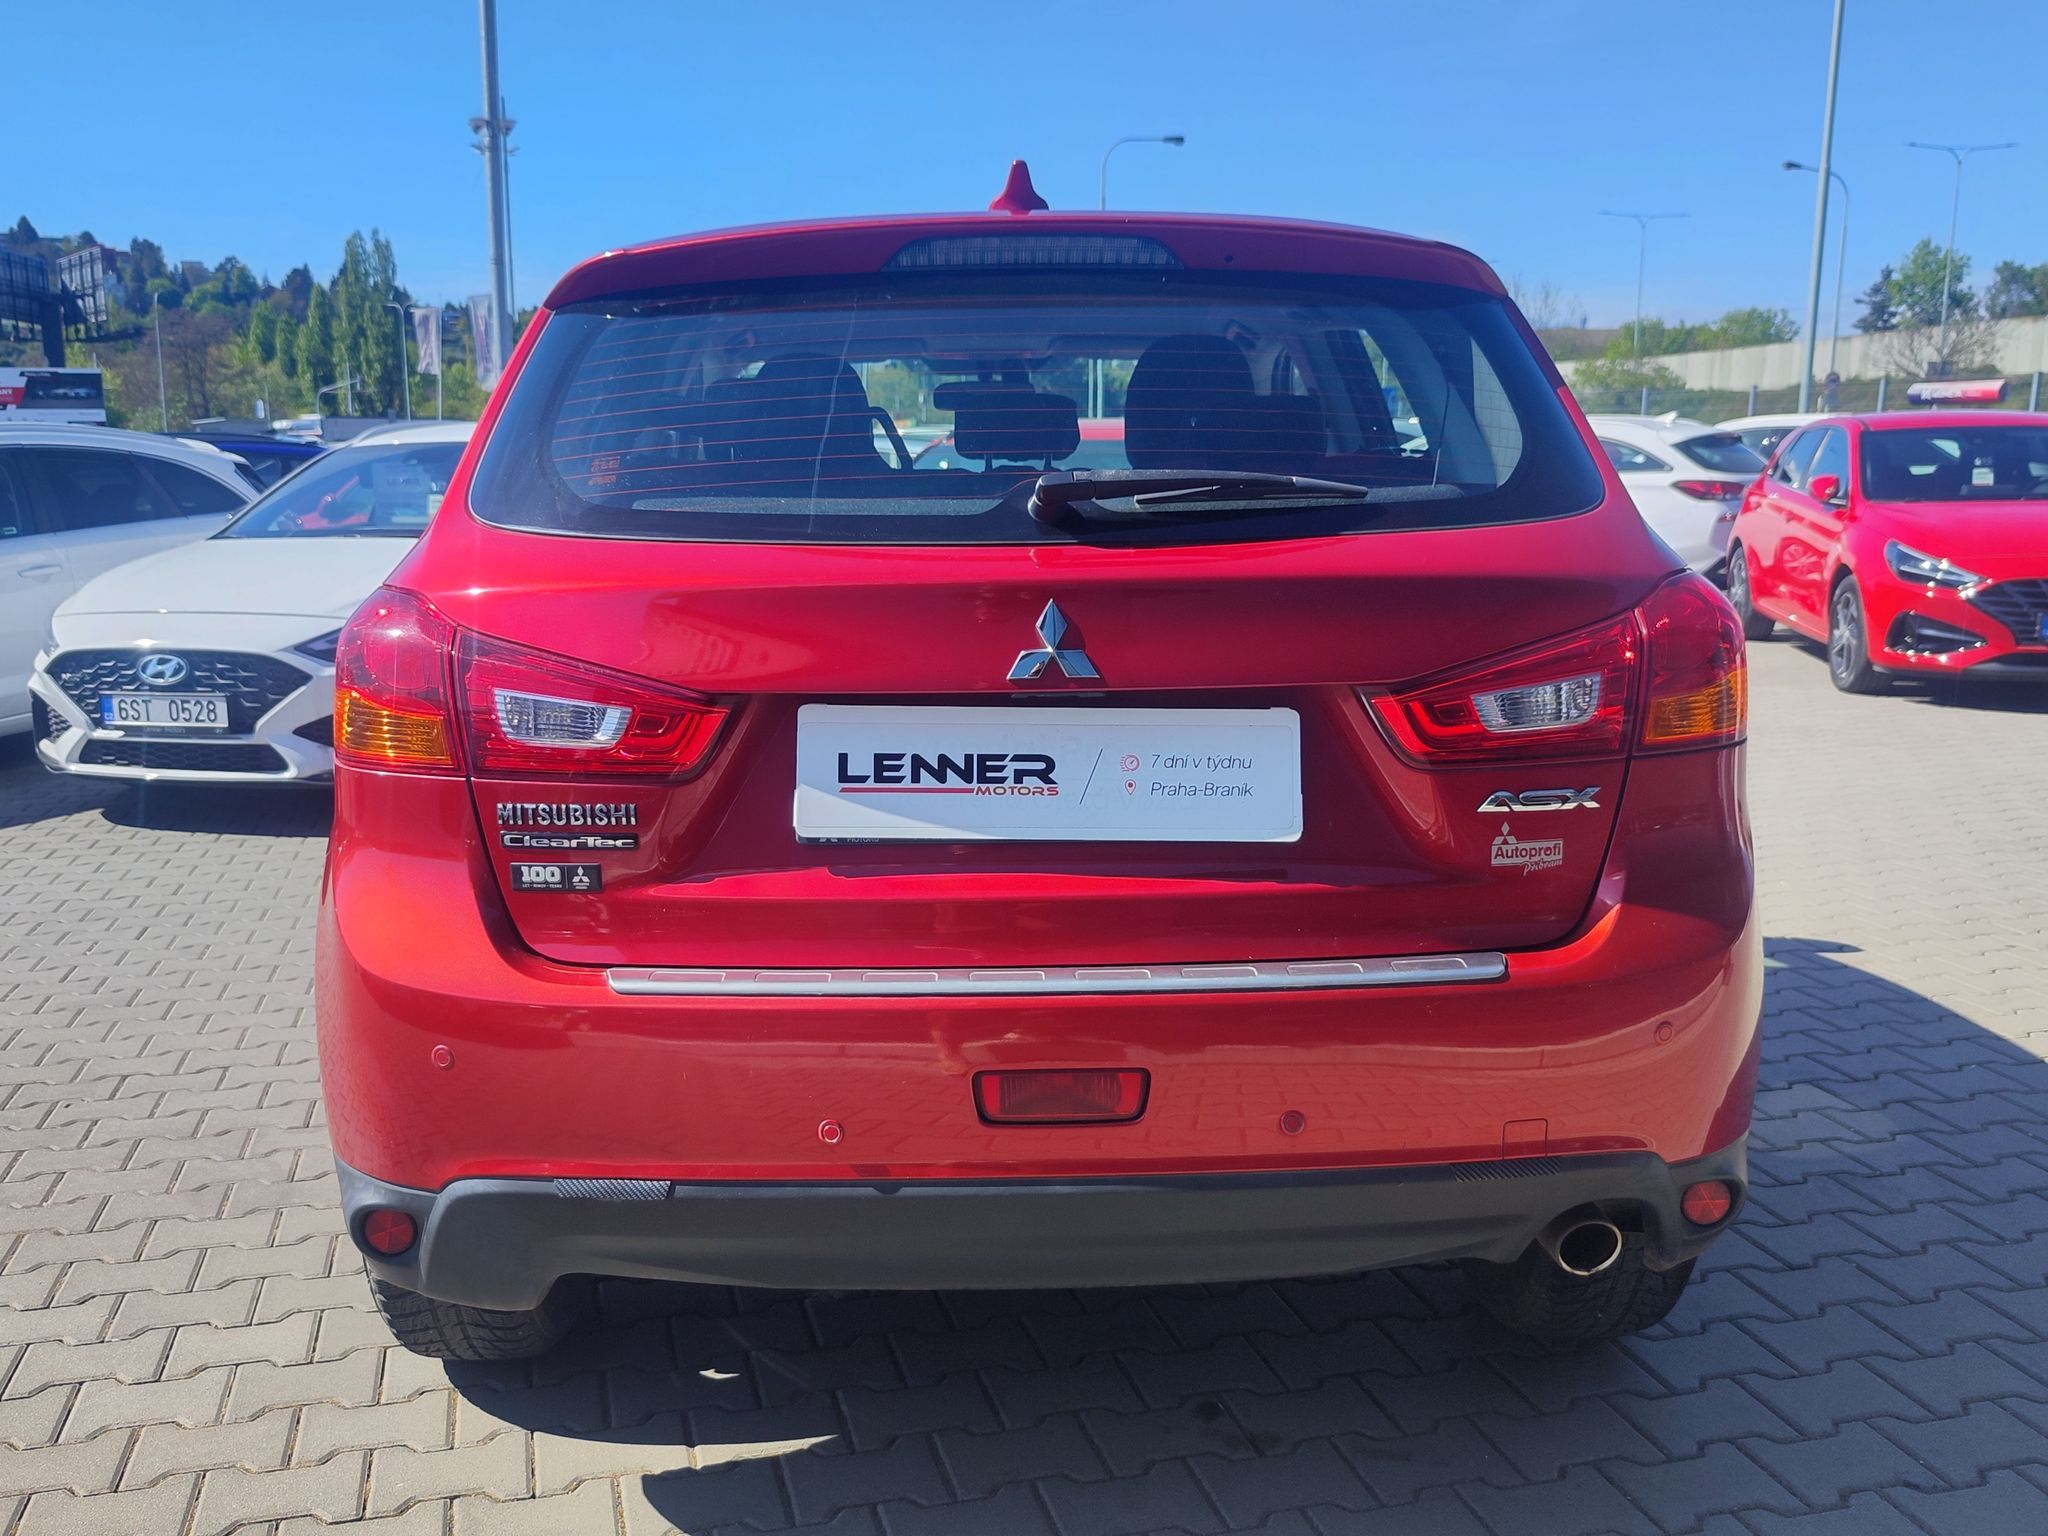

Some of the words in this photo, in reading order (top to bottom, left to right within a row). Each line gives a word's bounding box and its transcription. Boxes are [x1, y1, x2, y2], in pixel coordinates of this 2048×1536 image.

[118, 699, 152, 721] 6ST
[168, 700, 217, 723] 0528
[838, 753, 1058, 784] LENNER
[1151, 754, 1160, 768] 7
[1163, 754, 1190, 769] dní
[1193, 758, 1202, 769] v
[1207, 754, 1252, 772] týdnu
[975, 786, 1059, 796] MOTORS
[1150, 782, 1254, 797] Praha-Braník
[1477, 787, 1601, 812] ASX
[497, 803, 637, 826] MITSUBISHI
[503, 835, 636, 848] ClearTec
[1494, 843, 1562, 860] Autoprofi
[521, 866, 561, 883] 100
